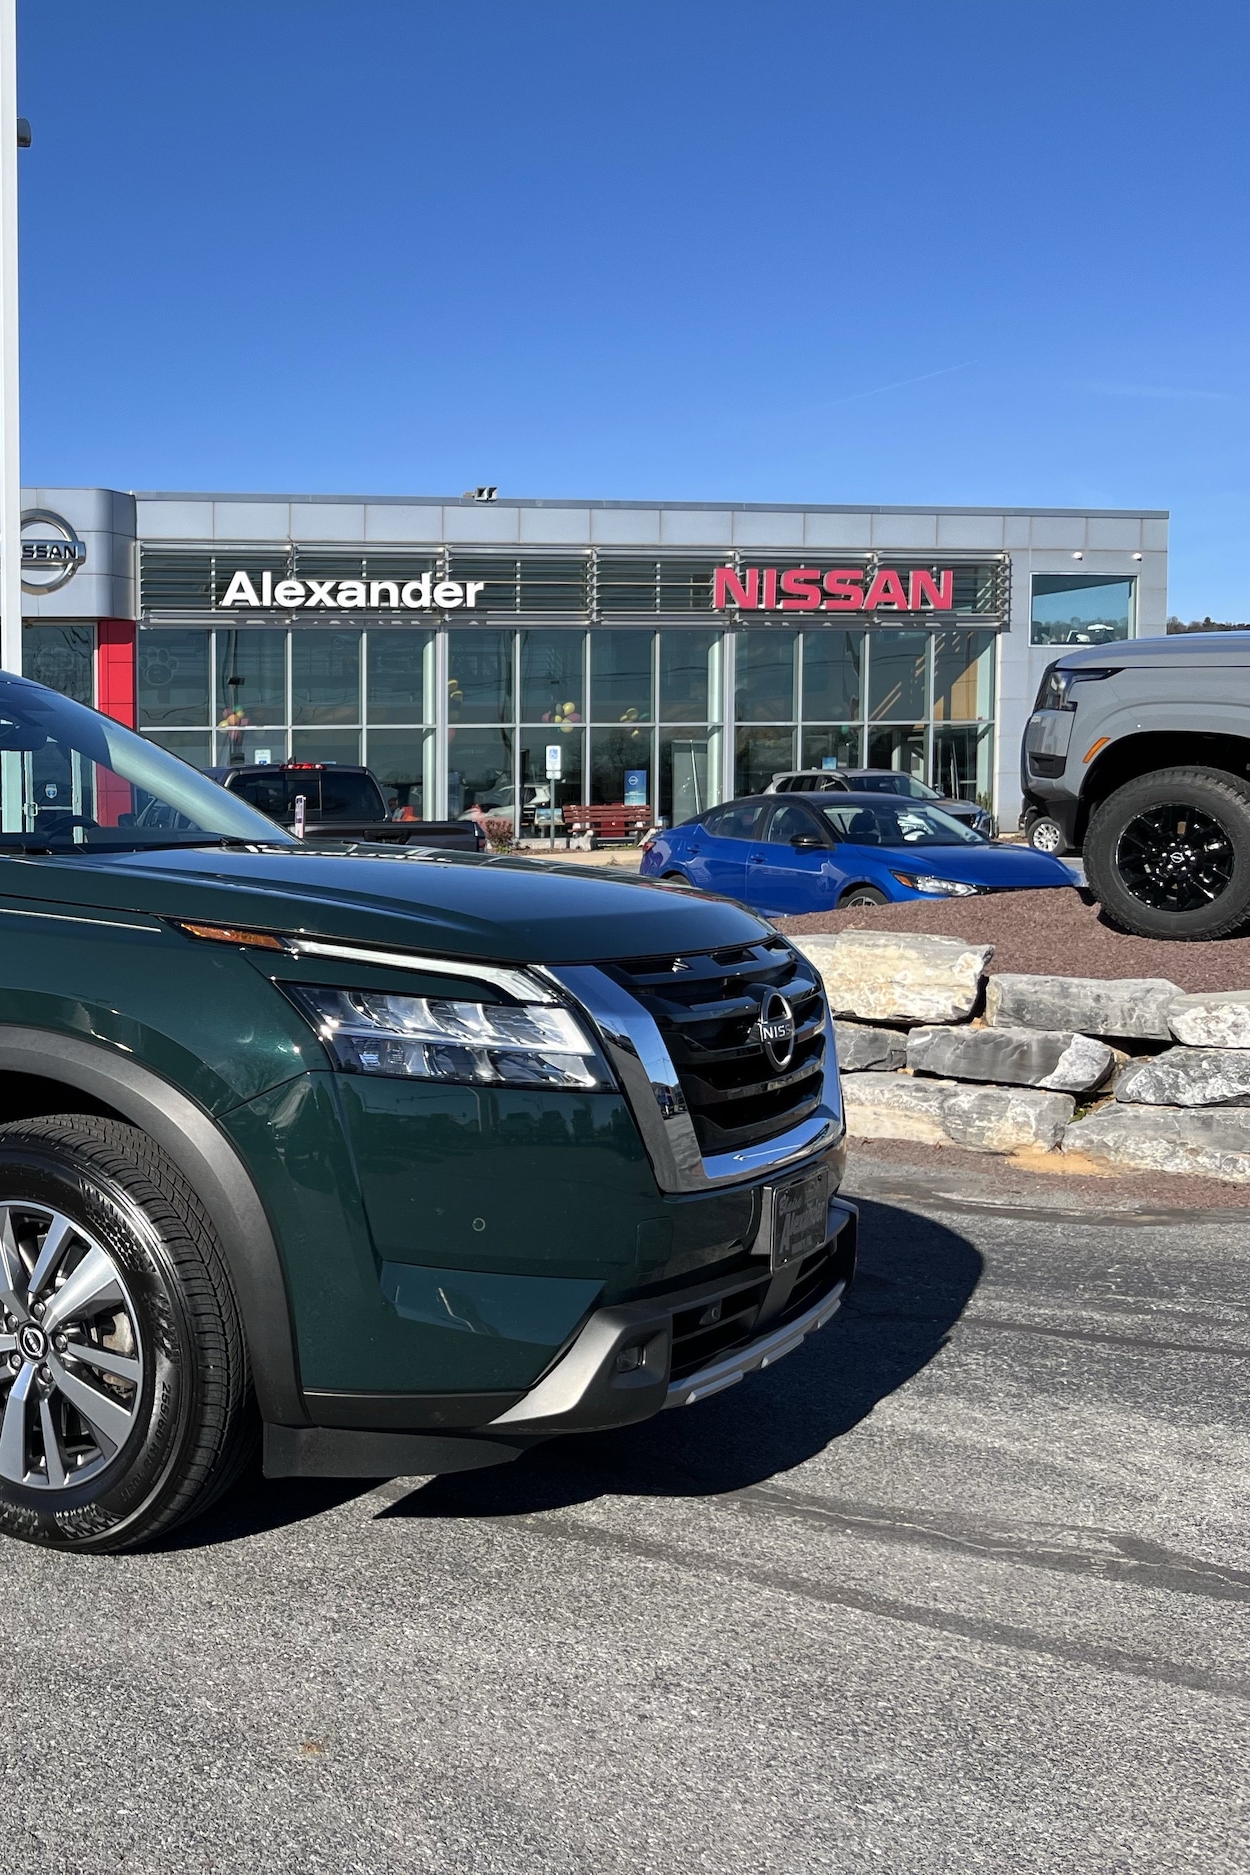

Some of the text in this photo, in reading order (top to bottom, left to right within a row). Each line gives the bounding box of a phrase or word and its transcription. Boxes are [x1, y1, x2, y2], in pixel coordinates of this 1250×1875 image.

[21, 544, 79, 560] SSAN
[220, 571, 485, 609] Alexander
[713, 568, 953, 610] NISSAN
[763, 1024, 792, 1040] NISS
[155, 1381, 172, 1439] 255/60
